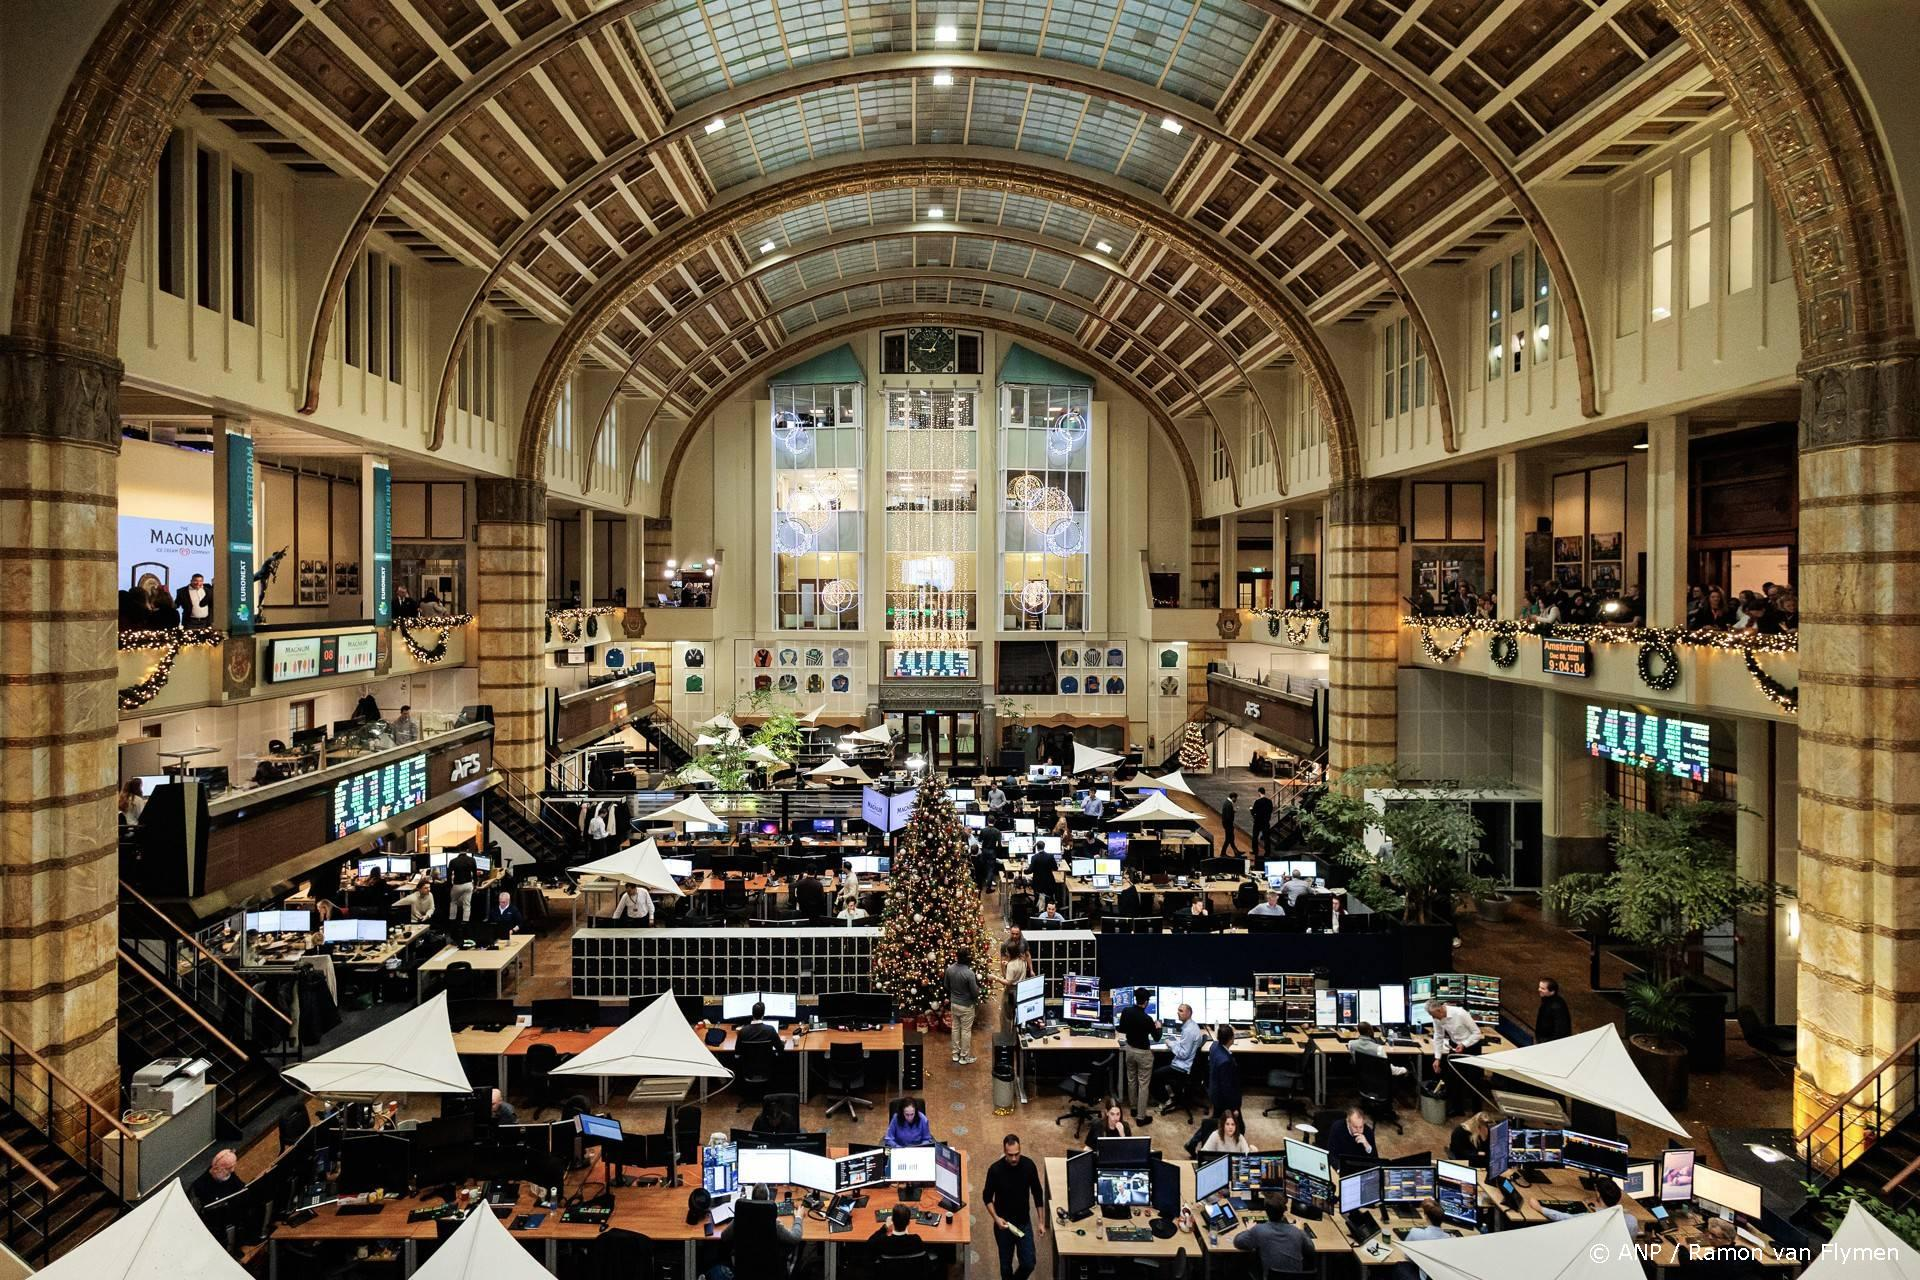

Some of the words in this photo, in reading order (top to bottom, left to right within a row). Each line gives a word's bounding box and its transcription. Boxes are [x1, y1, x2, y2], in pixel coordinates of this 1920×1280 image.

[150, 529, 214, 547] MAGNUM
[1544, 641, 1585, 653] Amsterdam
[1549, 660, 1586, 674] 9:04:04
